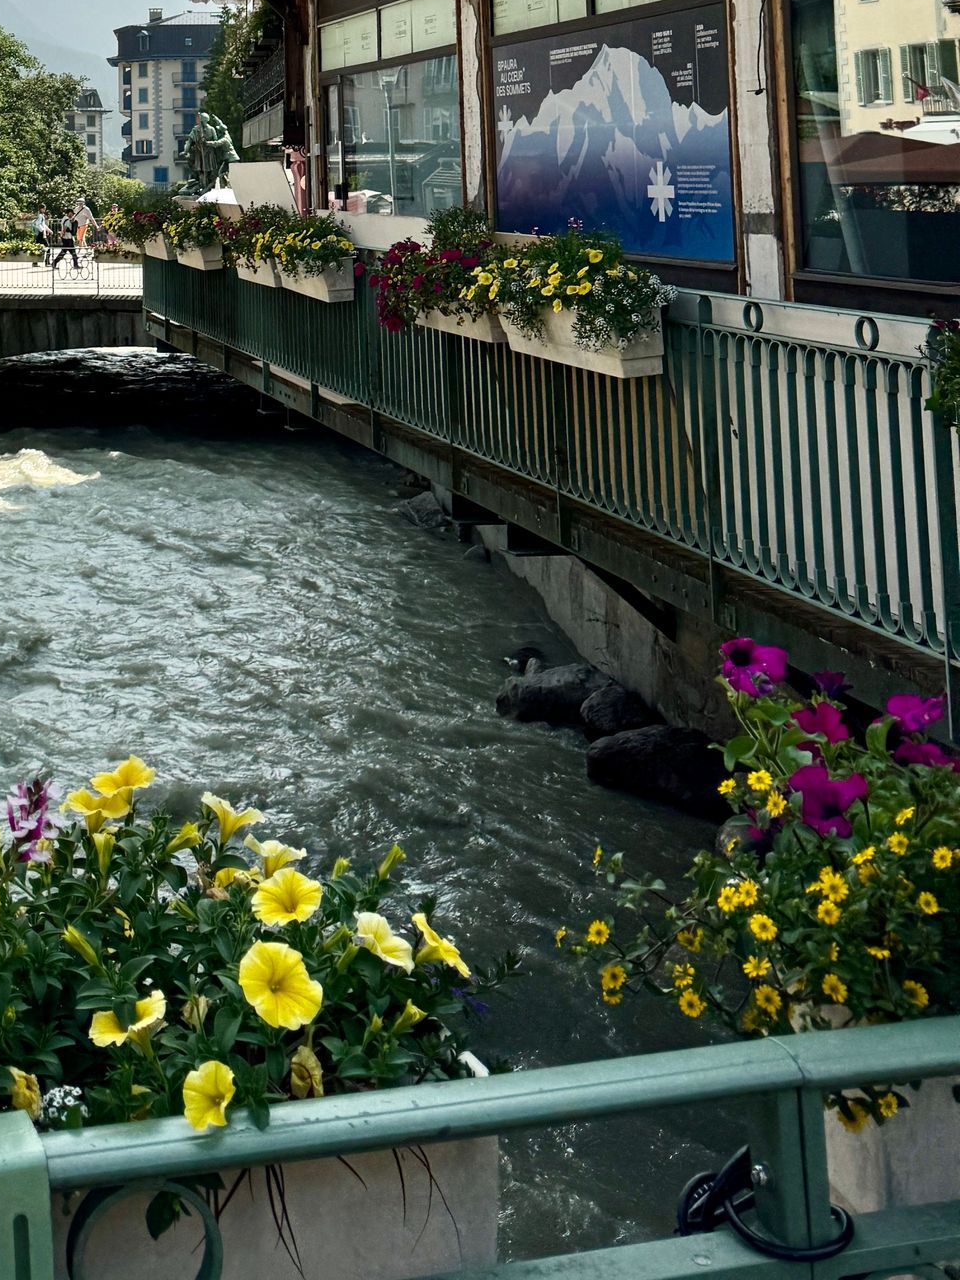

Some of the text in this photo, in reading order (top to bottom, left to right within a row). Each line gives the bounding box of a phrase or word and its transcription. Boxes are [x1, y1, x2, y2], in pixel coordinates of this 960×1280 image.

[501, 72, 508, 83] AU
[496, 82, 531, 96] DES SOMMETS
